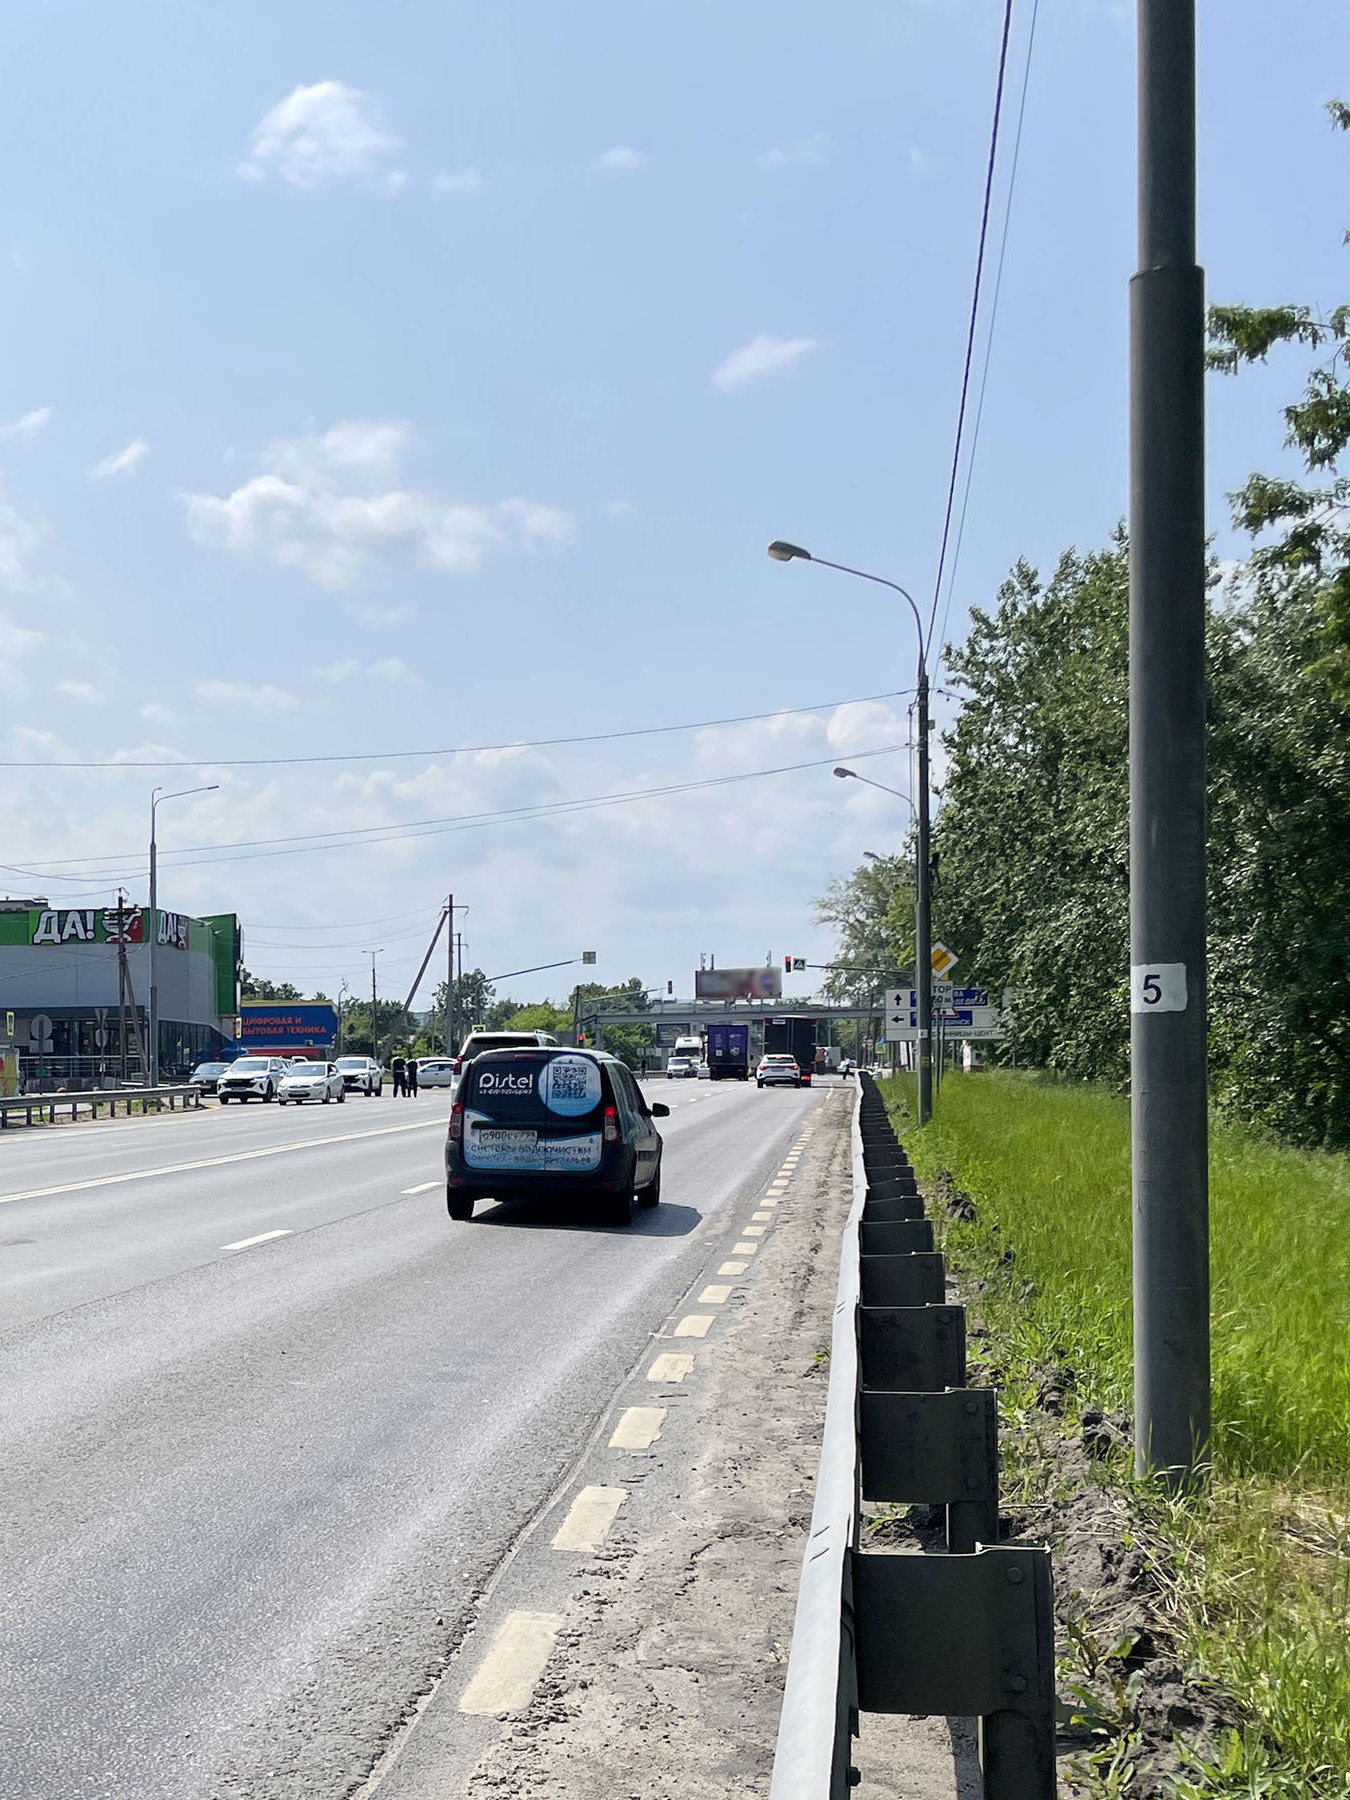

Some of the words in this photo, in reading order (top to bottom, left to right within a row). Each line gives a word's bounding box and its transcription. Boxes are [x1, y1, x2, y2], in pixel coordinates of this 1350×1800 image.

[33, 910, 96, 945] ДА!
[157, 911, 177, 945] ДА!
[1143, 974, 1162, 1005] 5
[243, 1017, 292, 1025] ЦИФРОВАЯ
[243, 1026, 284, 1034] БЫТОВАЯ
[288, 1026, 327, 1034] ТЕХНИКА
